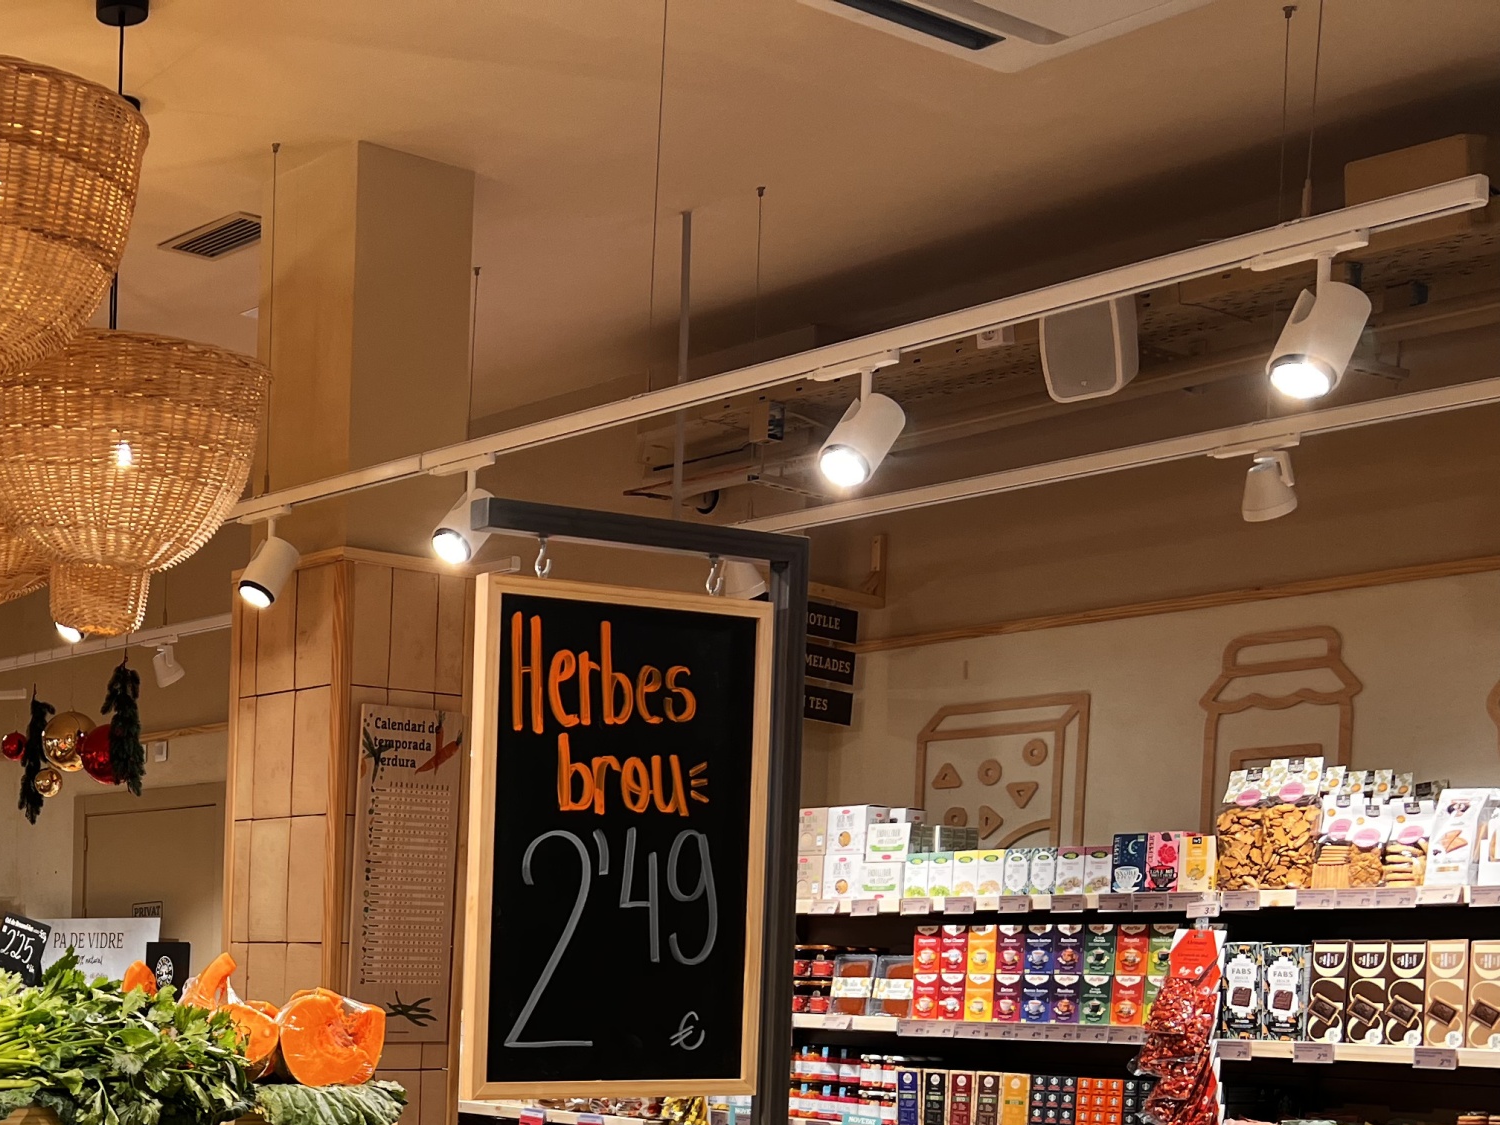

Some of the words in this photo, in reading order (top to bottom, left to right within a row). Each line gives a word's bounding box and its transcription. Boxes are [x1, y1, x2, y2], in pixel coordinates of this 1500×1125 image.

[511, 611, 696, 734] Herbes
[809, 696, 828, 711] TES
[375, 717, 426, 734] Calendari
[428, 721, 442, 734] de
[373, 735, 432, 752] temporada
[378, 755, 417, 769] erdura
[557, 733, 689, 817] brou
[134, 905, 160, 917] PRIVAT
[53, 932, 67, 949] PA
[69, 932, 85, 949] DE
[88, 932, 125, 949] VIDRE
[1273, 970, 1293, 978] FABS
[669, 1010, 706, 1050] €
